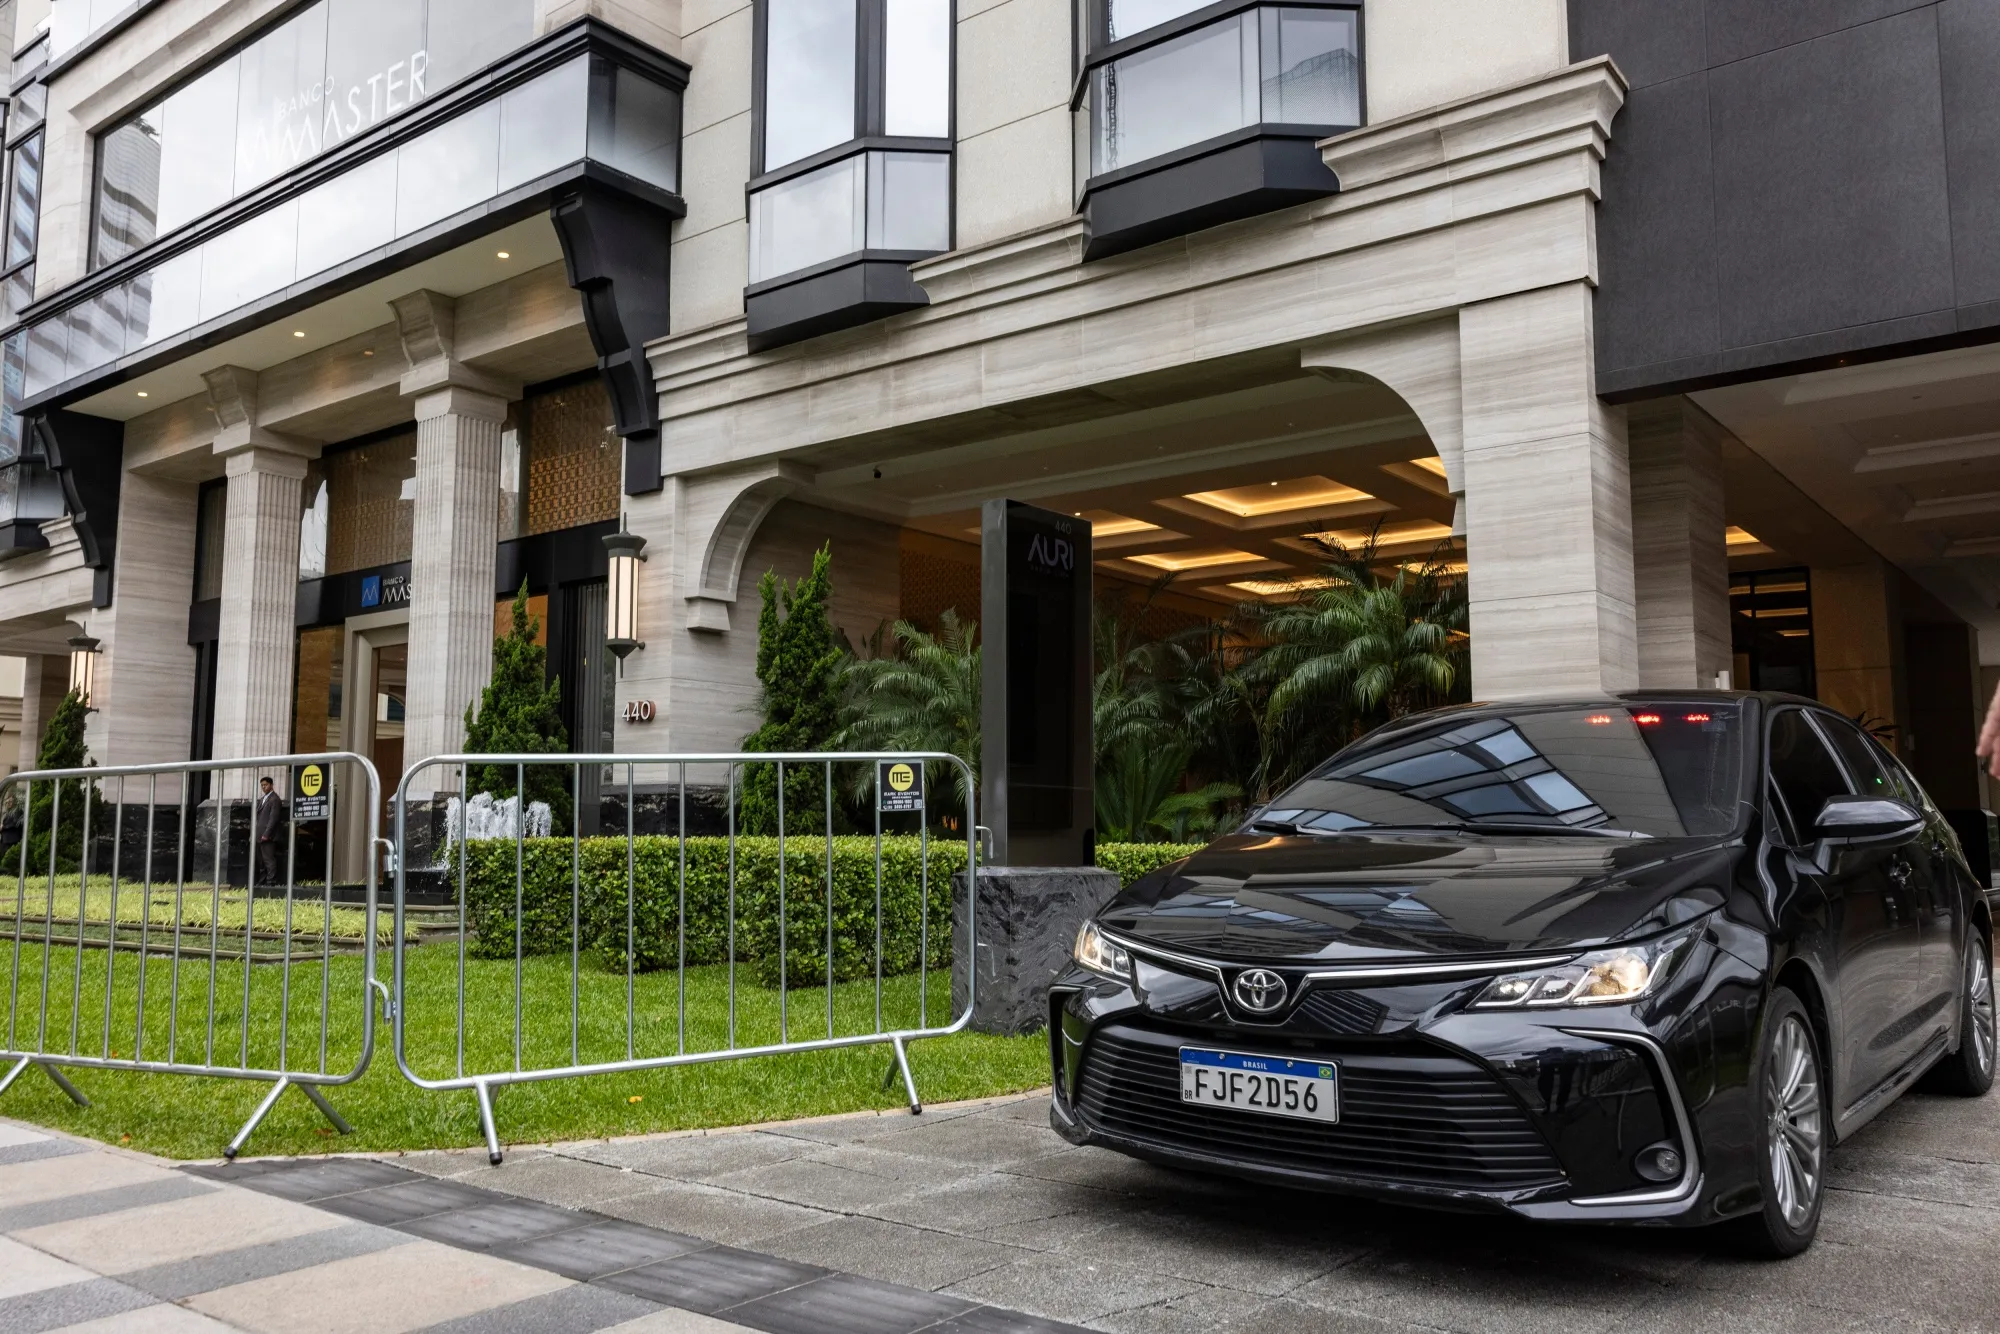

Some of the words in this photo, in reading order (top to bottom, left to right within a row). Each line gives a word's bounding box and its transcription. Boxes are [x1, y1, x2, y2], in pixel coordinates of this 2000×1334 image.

[278, 75, 335, 121] BANCO
[280, 50, 428, 165] MASTER
[1055, 520, 1072, 535] 440
[1028, 533, 1074, 571] AURI
[383, 575, 404, 587] BANCO
[622, 700, 652, 722] 440
[304, 773, 320, 787] ME
[892, 772, 910, 783] ME
[1242, 1060, 1268, 1070] BRASIL
[1184, 1089, 1193, 1100] BR
[1195, 1068, 1318, 1113] FJF2D56
